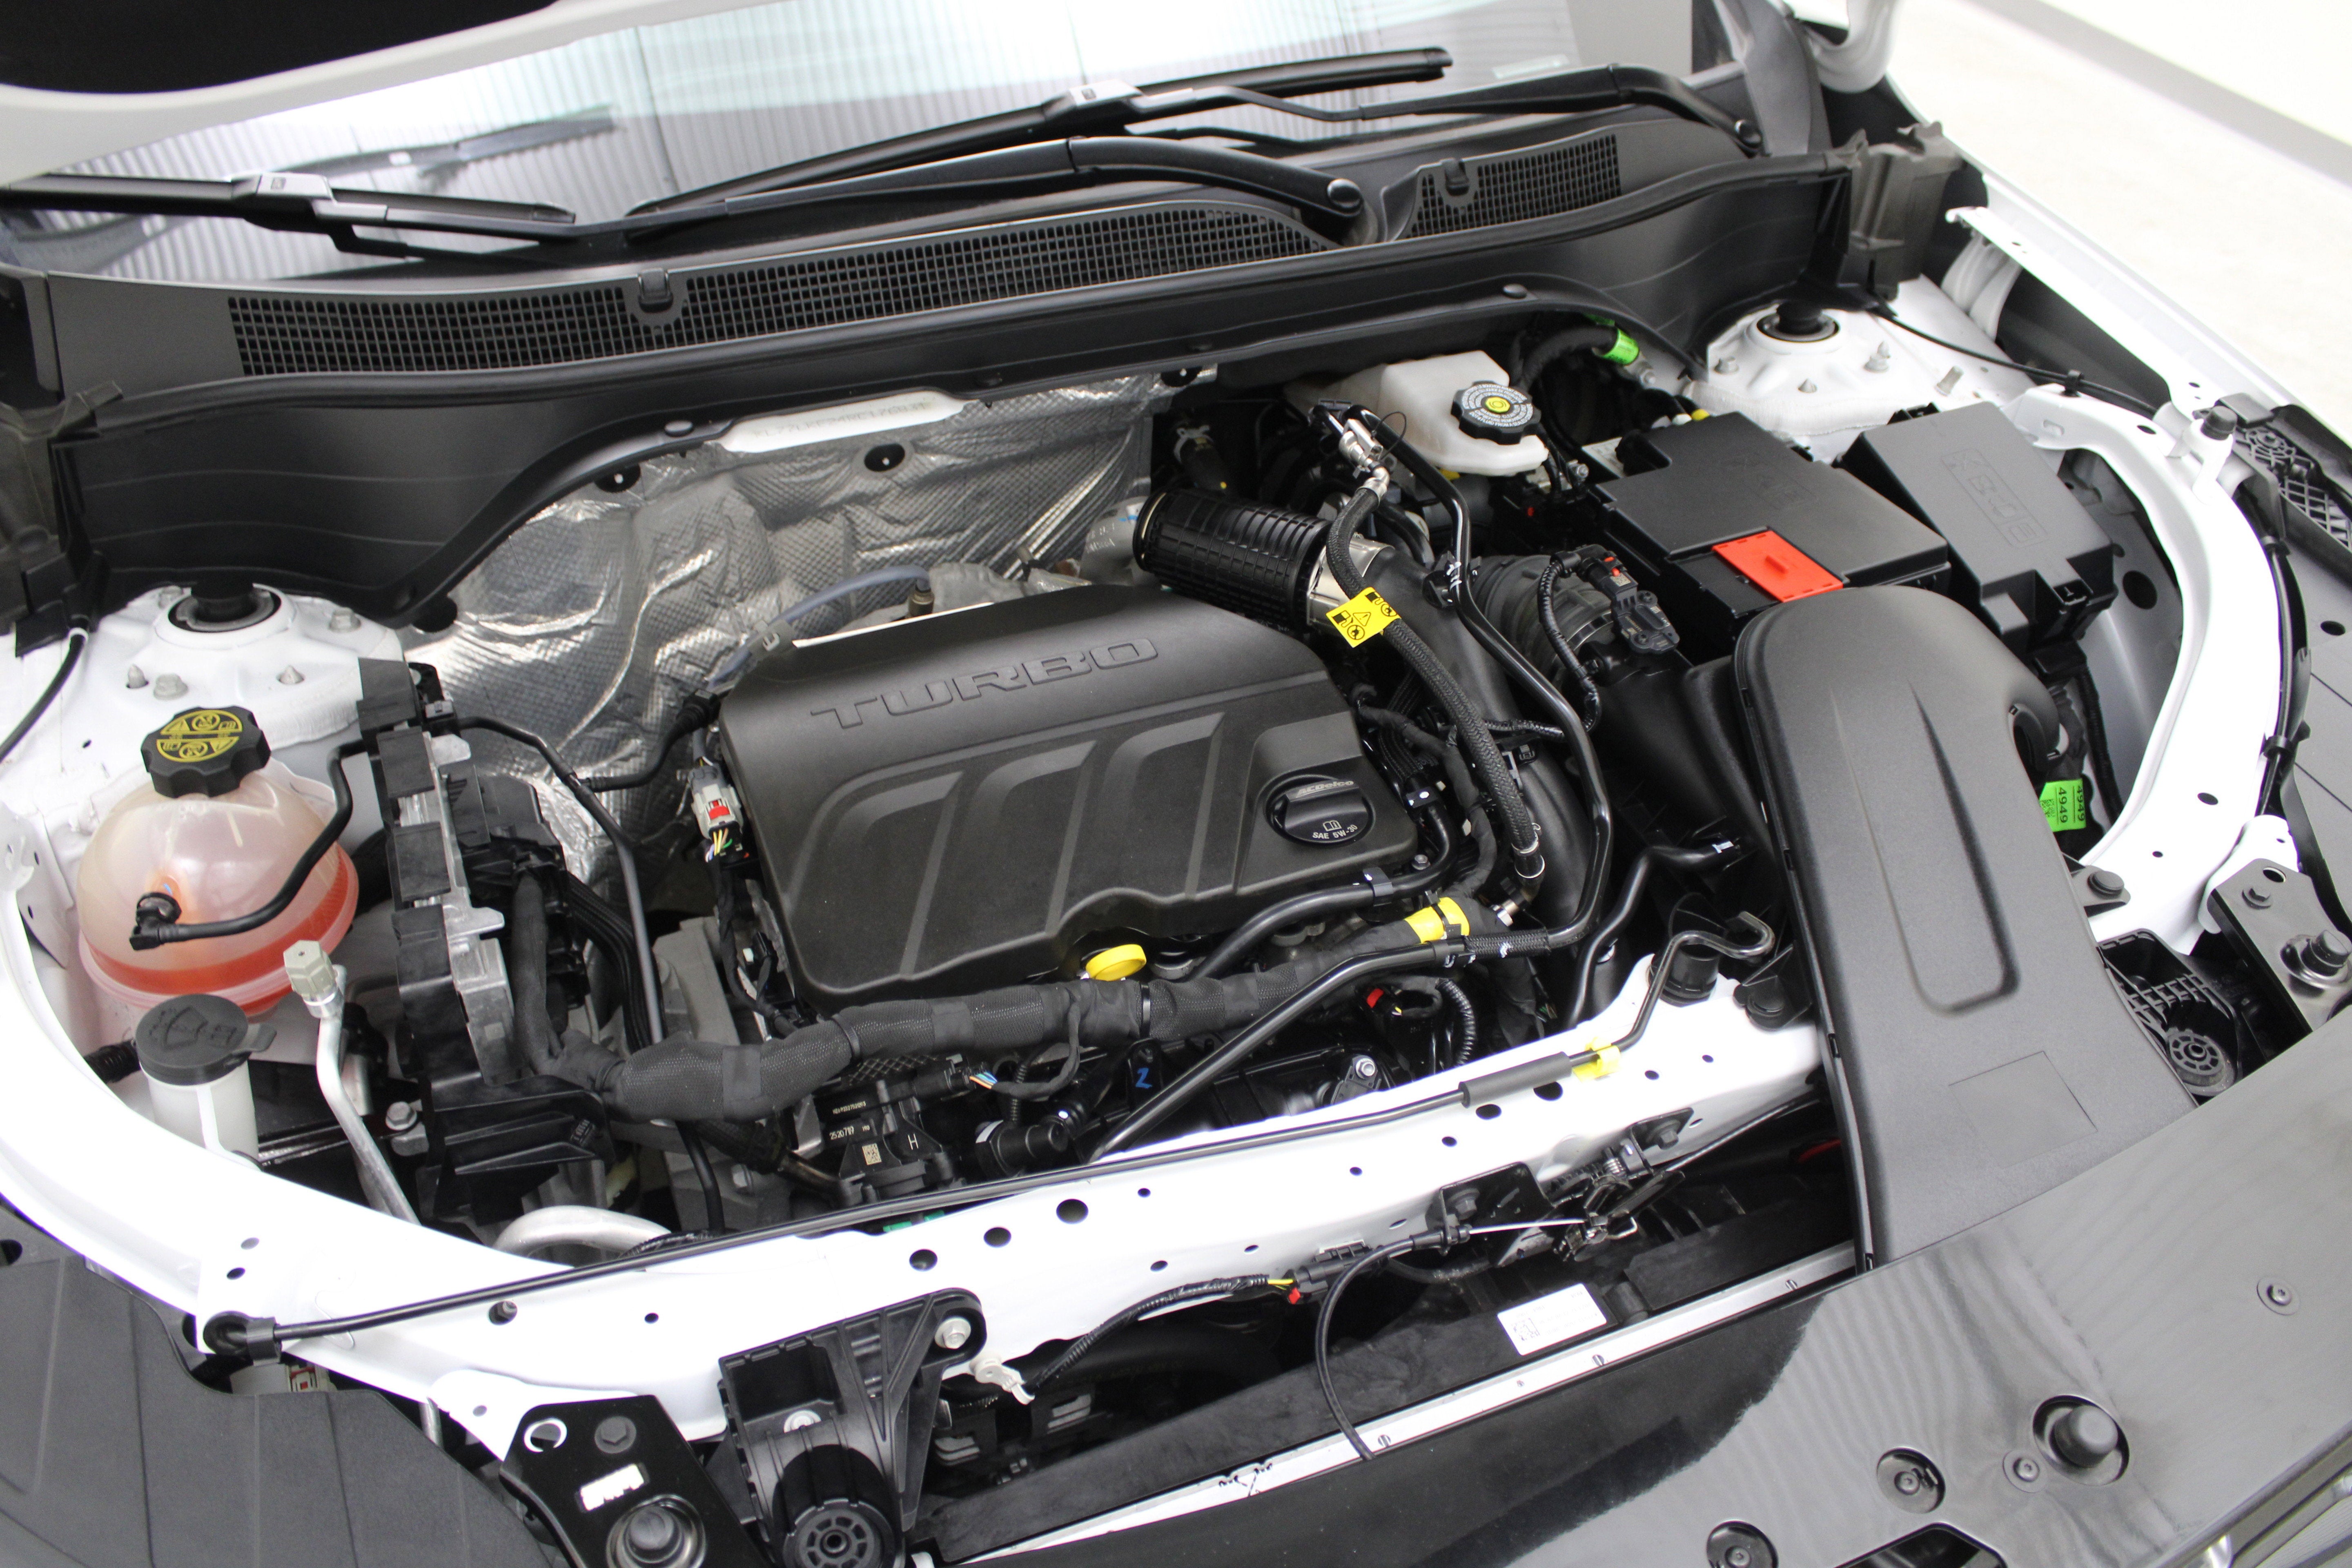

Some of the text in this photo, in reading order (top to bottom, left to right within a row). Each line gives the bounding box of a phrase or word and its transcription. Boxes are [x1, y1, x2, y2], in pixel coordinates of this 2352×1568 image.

[811, 637, 1159, 730] TURBO
[1296, 780, 1354, 798] ACDelco
[2058, 786, 2068, 823] 4949
[2077, 785, 2085, 821] 4949
[1312, 824, 1358, 840] SAE 5W-30
[907, 1133, 919, 1150] H
